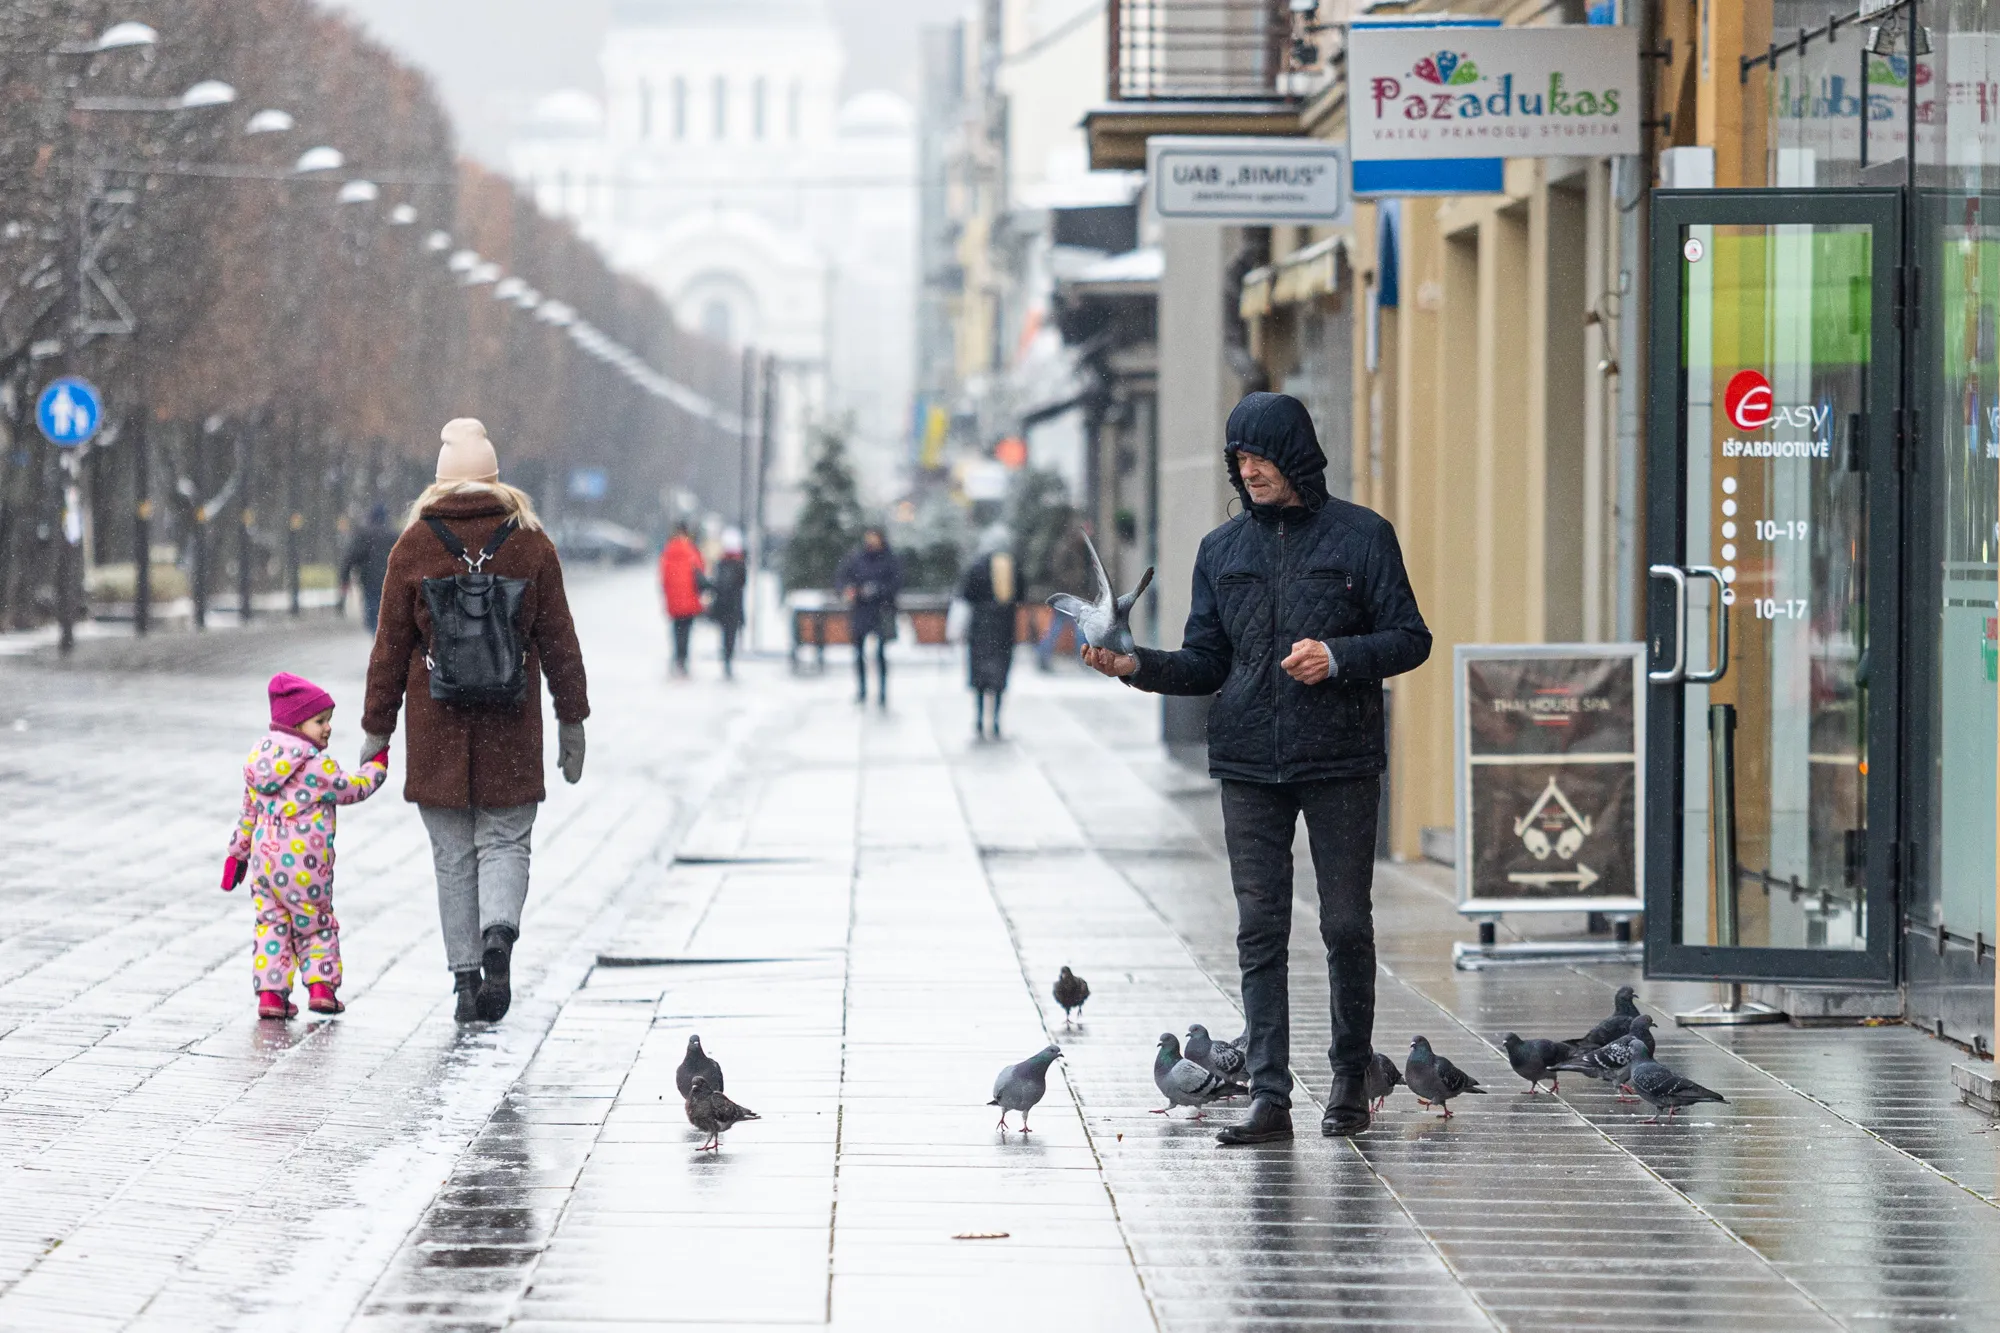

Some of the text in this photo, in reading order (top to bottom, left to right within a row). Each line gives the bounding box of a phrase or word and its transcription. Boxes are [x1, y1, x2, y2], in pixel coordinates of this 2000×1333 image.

[1371, 72, 1620, 120] Pazadukas
[1540, 122, 1620, 137] STUDIJA
[1173, 164, 1220, 185] UAB
[1722, 437, 1829, 457] IŠPARDUOTUVĖ
[1529, 698, 1579, 712] HOUSE
[1582, 698, 1611, 712] SPA
